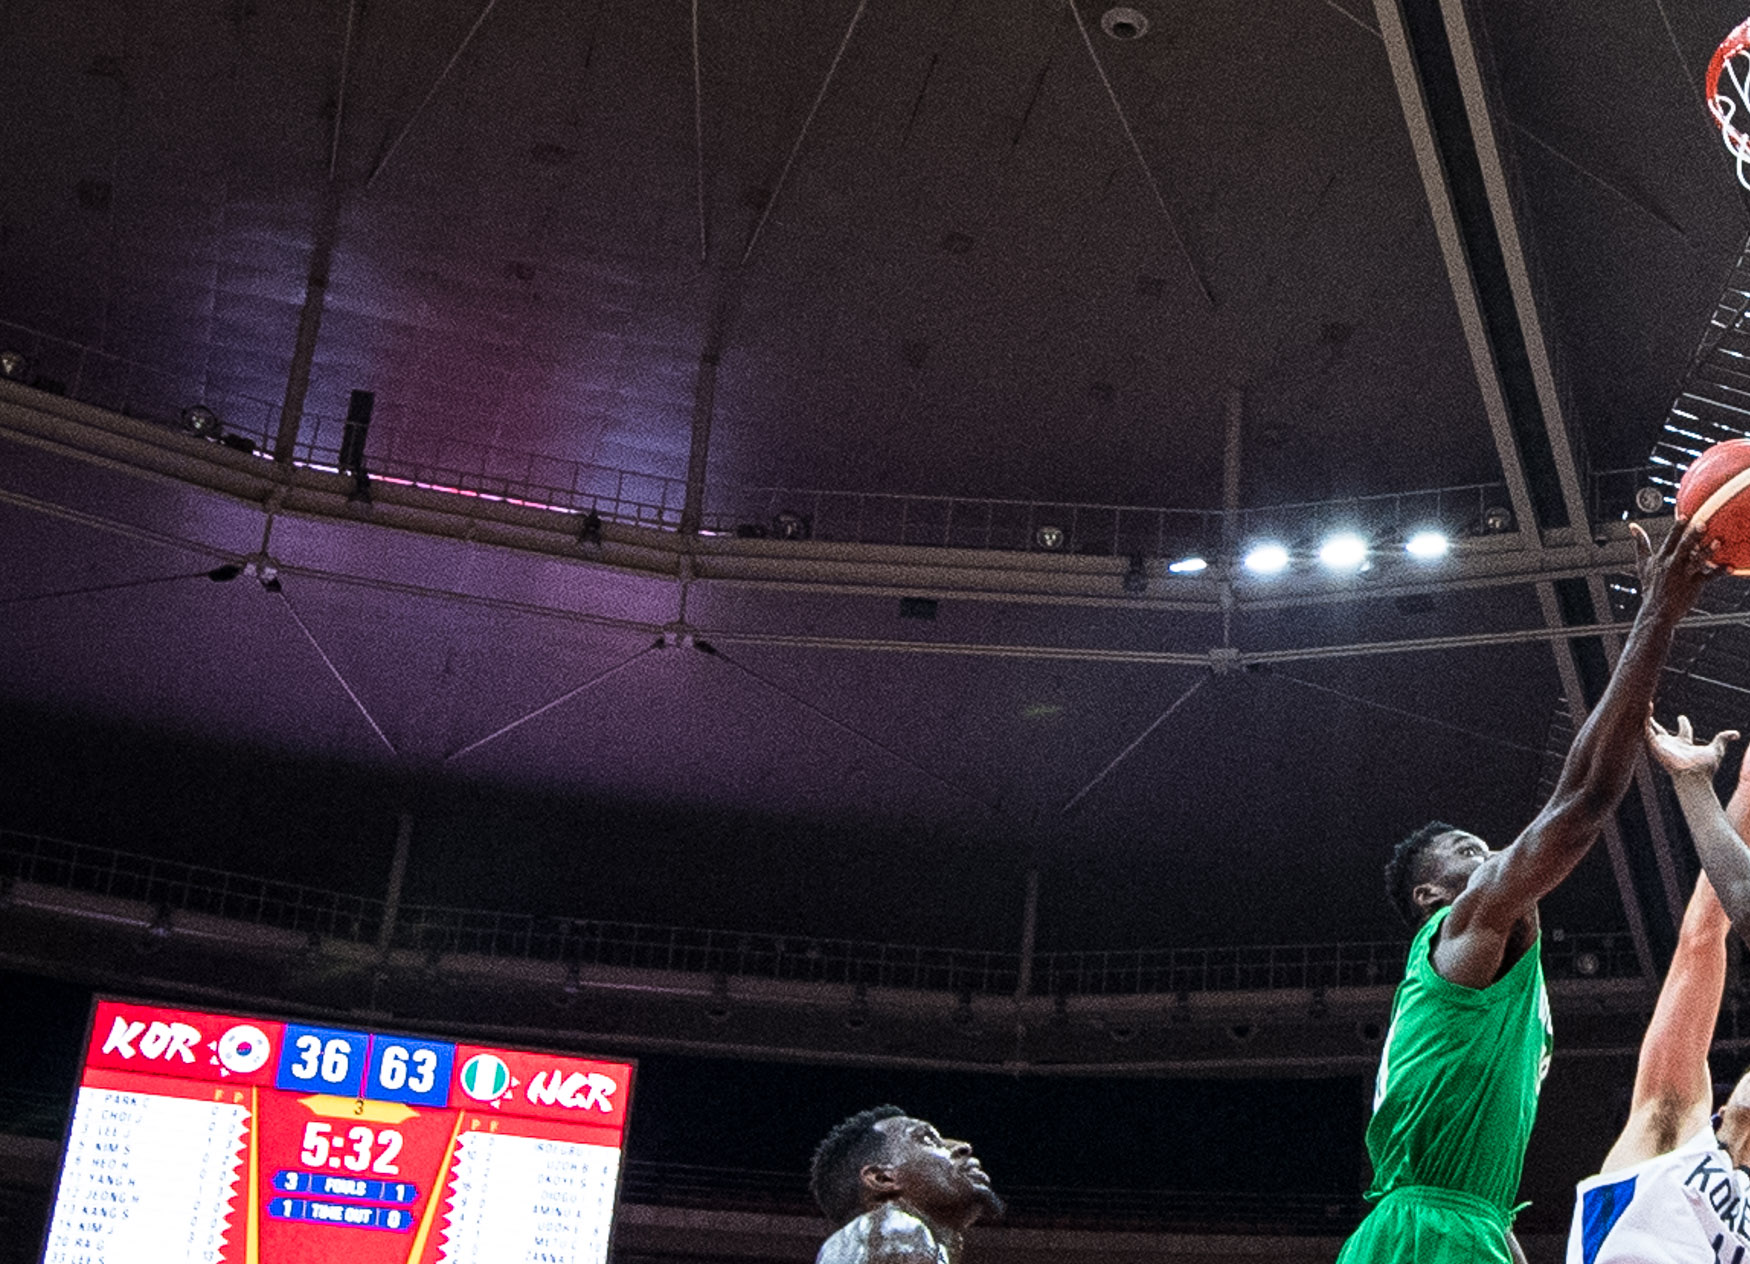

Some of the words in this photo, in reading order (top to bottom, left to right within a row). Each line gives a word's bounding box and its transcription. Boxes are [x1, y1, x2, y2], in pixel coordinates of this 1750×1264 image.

[102, 1016, 202, 1064] KOR
[292, 1035, 352, 1083] 36
[380, 1045, 438, 1093] 63
[354, 1100, 365, 1116] 3
[301, 1121, 403, 1175] 5:32
[284, 1172, 298, 1190] 3
[324, 1178, 367, 1196] FOULS
[396, 1184, 405, 1201] 1
[283, 1200, 292, 1217] 1
[311, 1203, 343, 1220] TIME
[344, 1207, 373, 1224] OUT
[386, 1210, 401, 1229] 0
